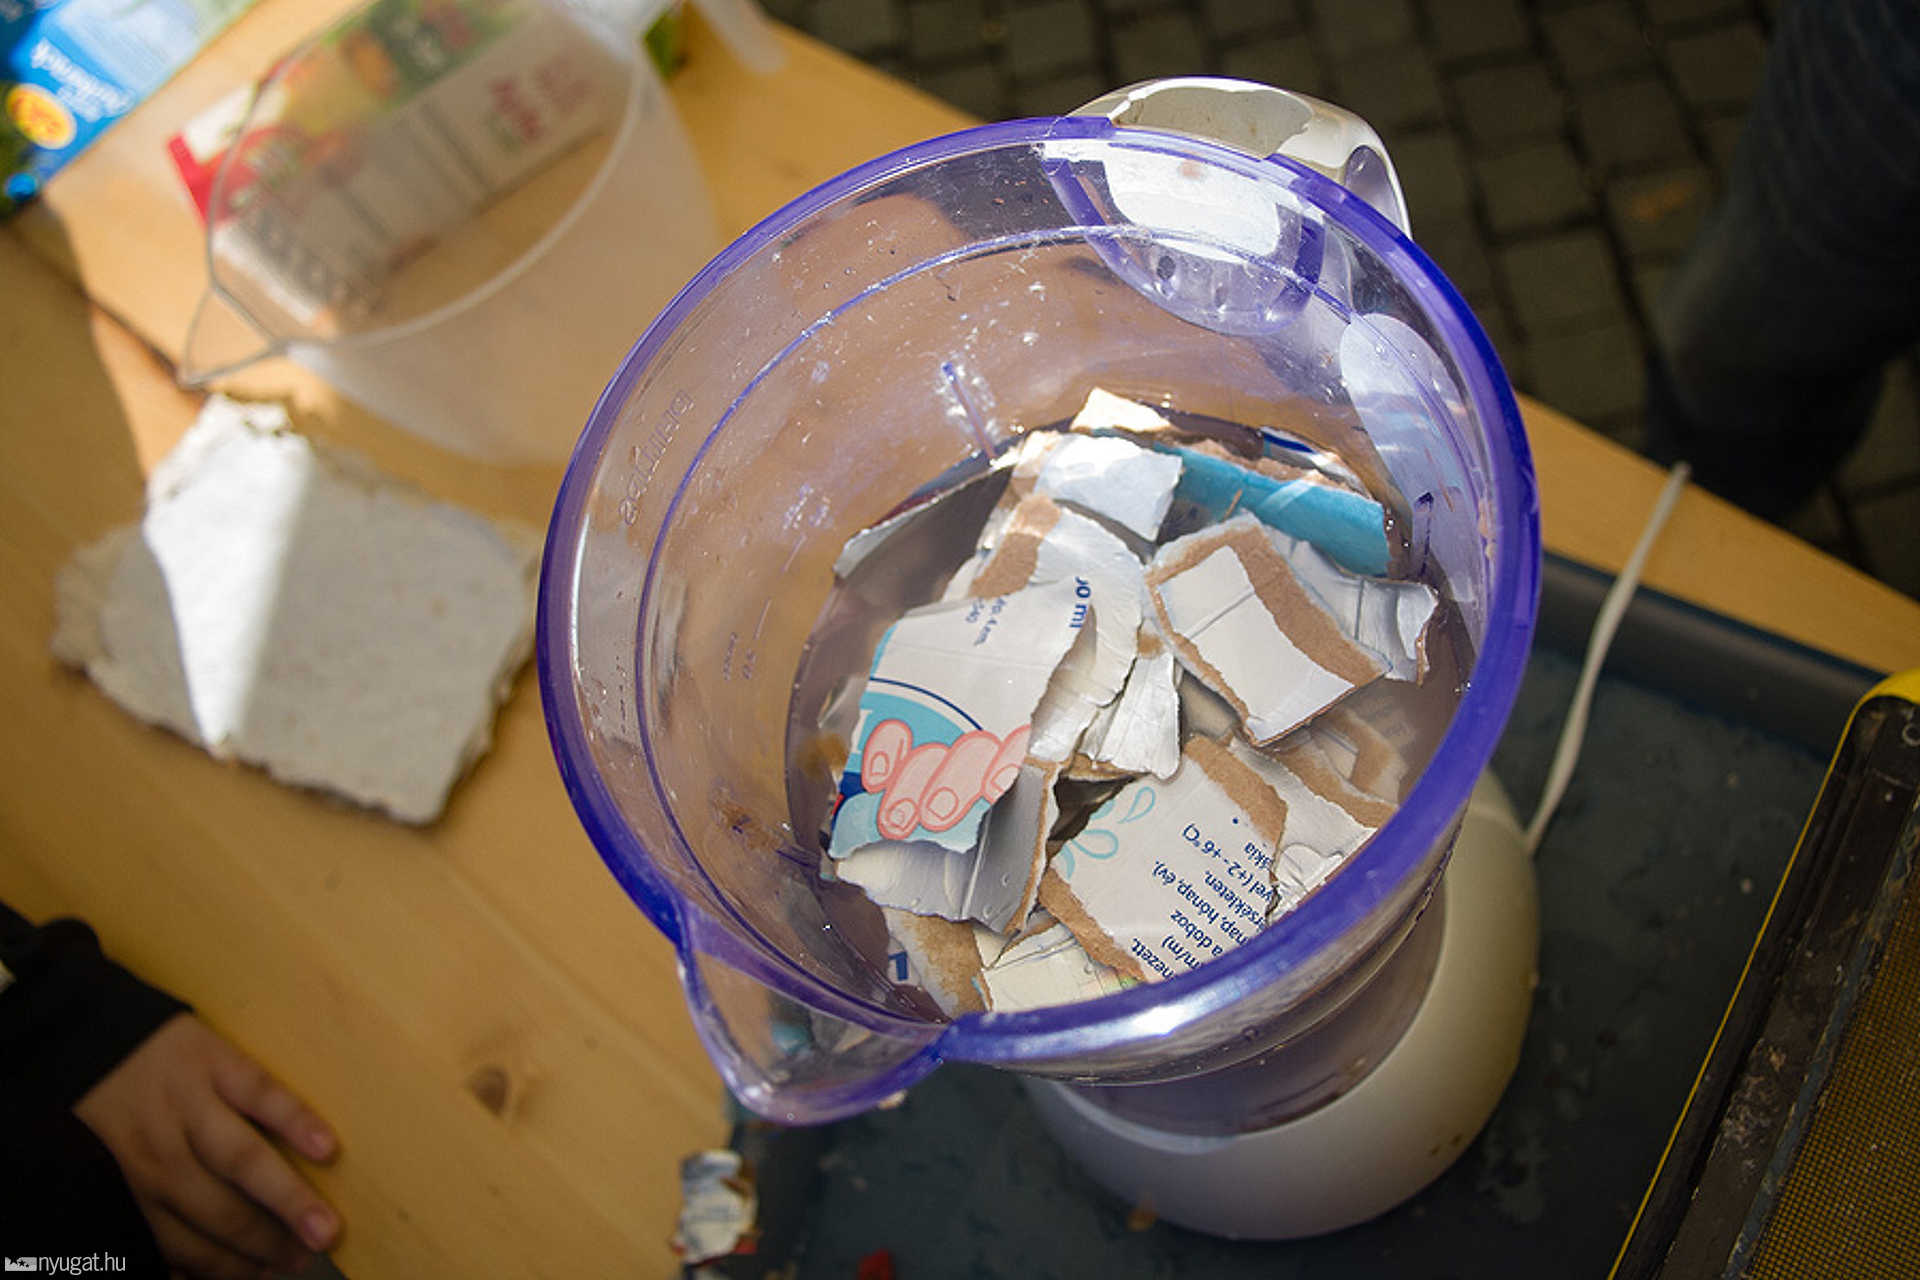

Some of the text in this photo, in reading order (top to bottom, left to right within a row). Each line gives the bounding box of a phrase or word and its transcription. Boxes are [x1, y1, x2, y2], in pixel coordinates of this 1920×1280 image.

[1176, 879, 1220, 925] hónap,
[1170, 909, 1223, 957] a doboz
